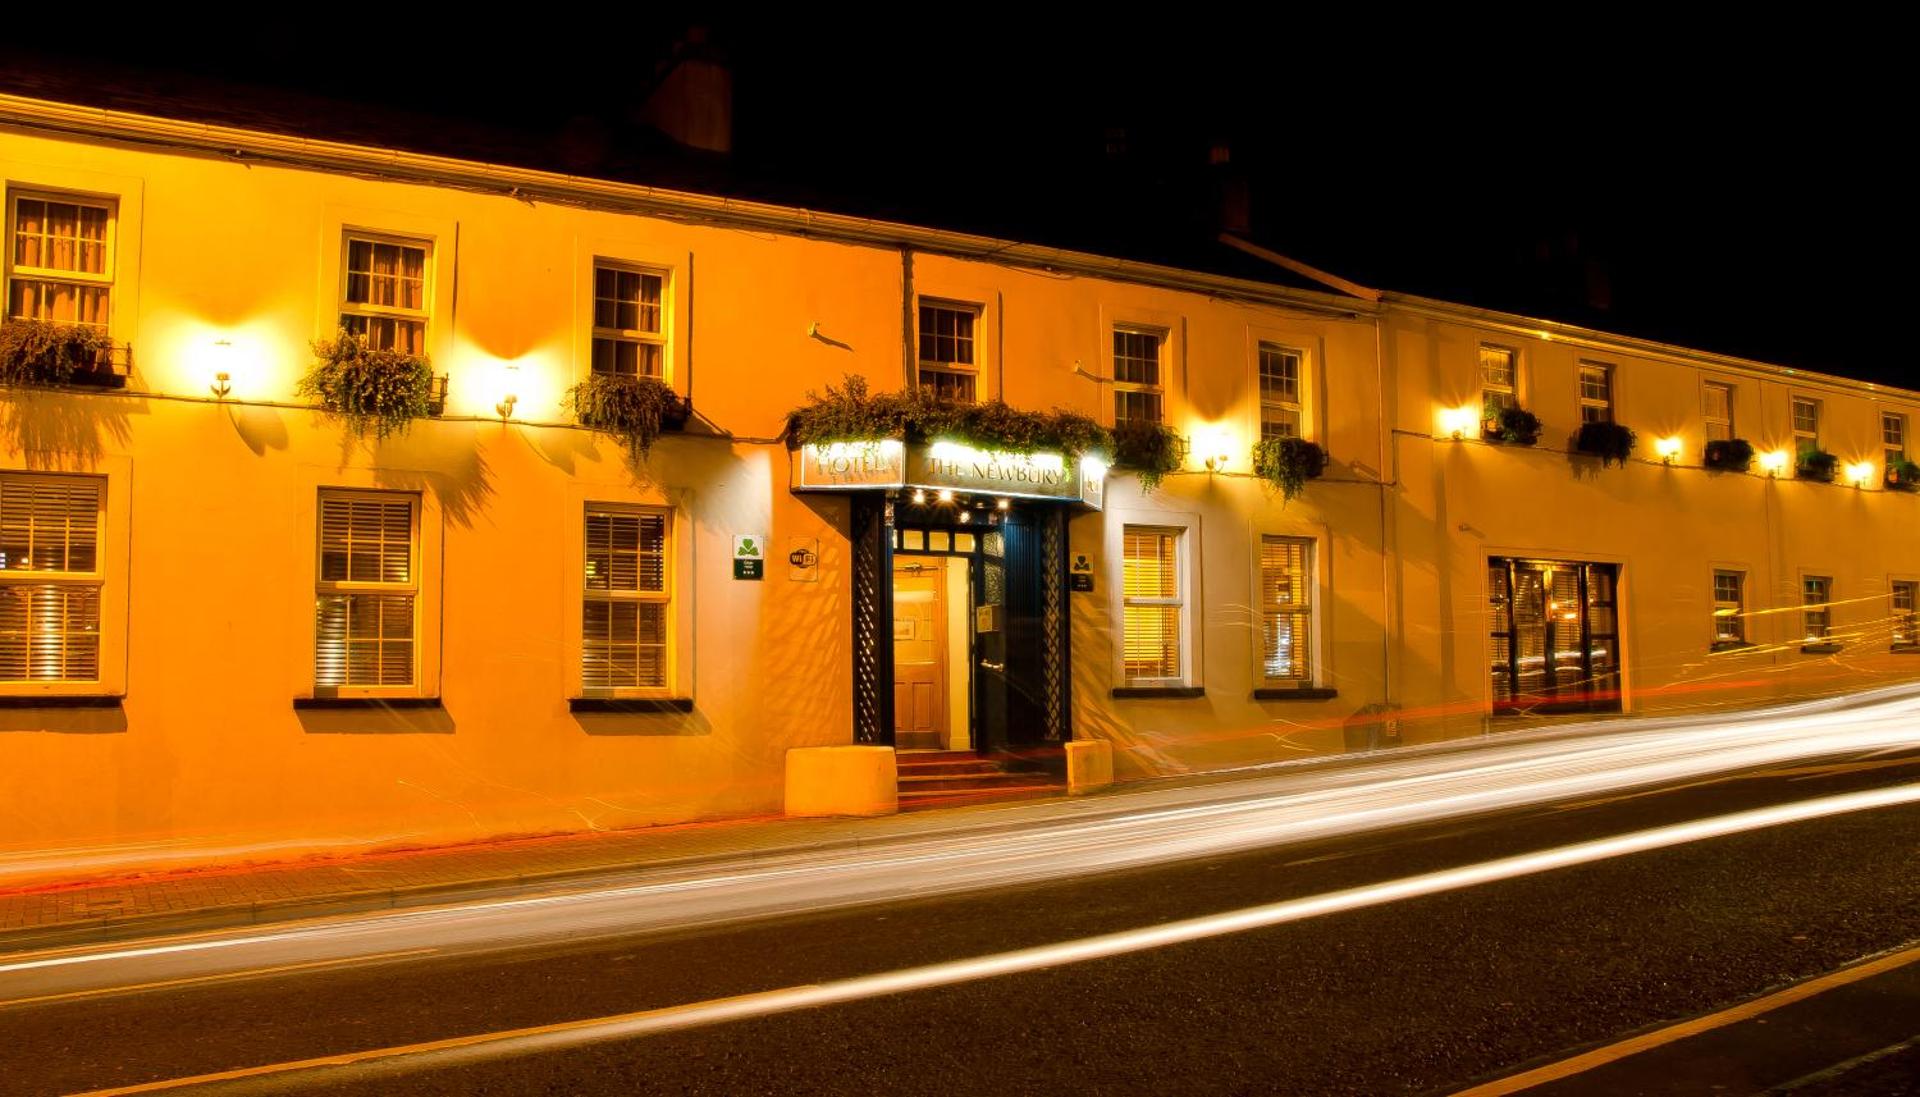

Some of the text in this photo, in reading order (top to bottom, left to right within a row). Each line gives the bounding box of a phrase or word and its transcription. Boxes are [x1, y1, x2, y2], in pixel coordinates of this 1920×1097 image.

[815, 454, 890, 475] HOTEL
[929, 457, 966, 477] THE
[971, 462, 1061, 486] NEWBURY
